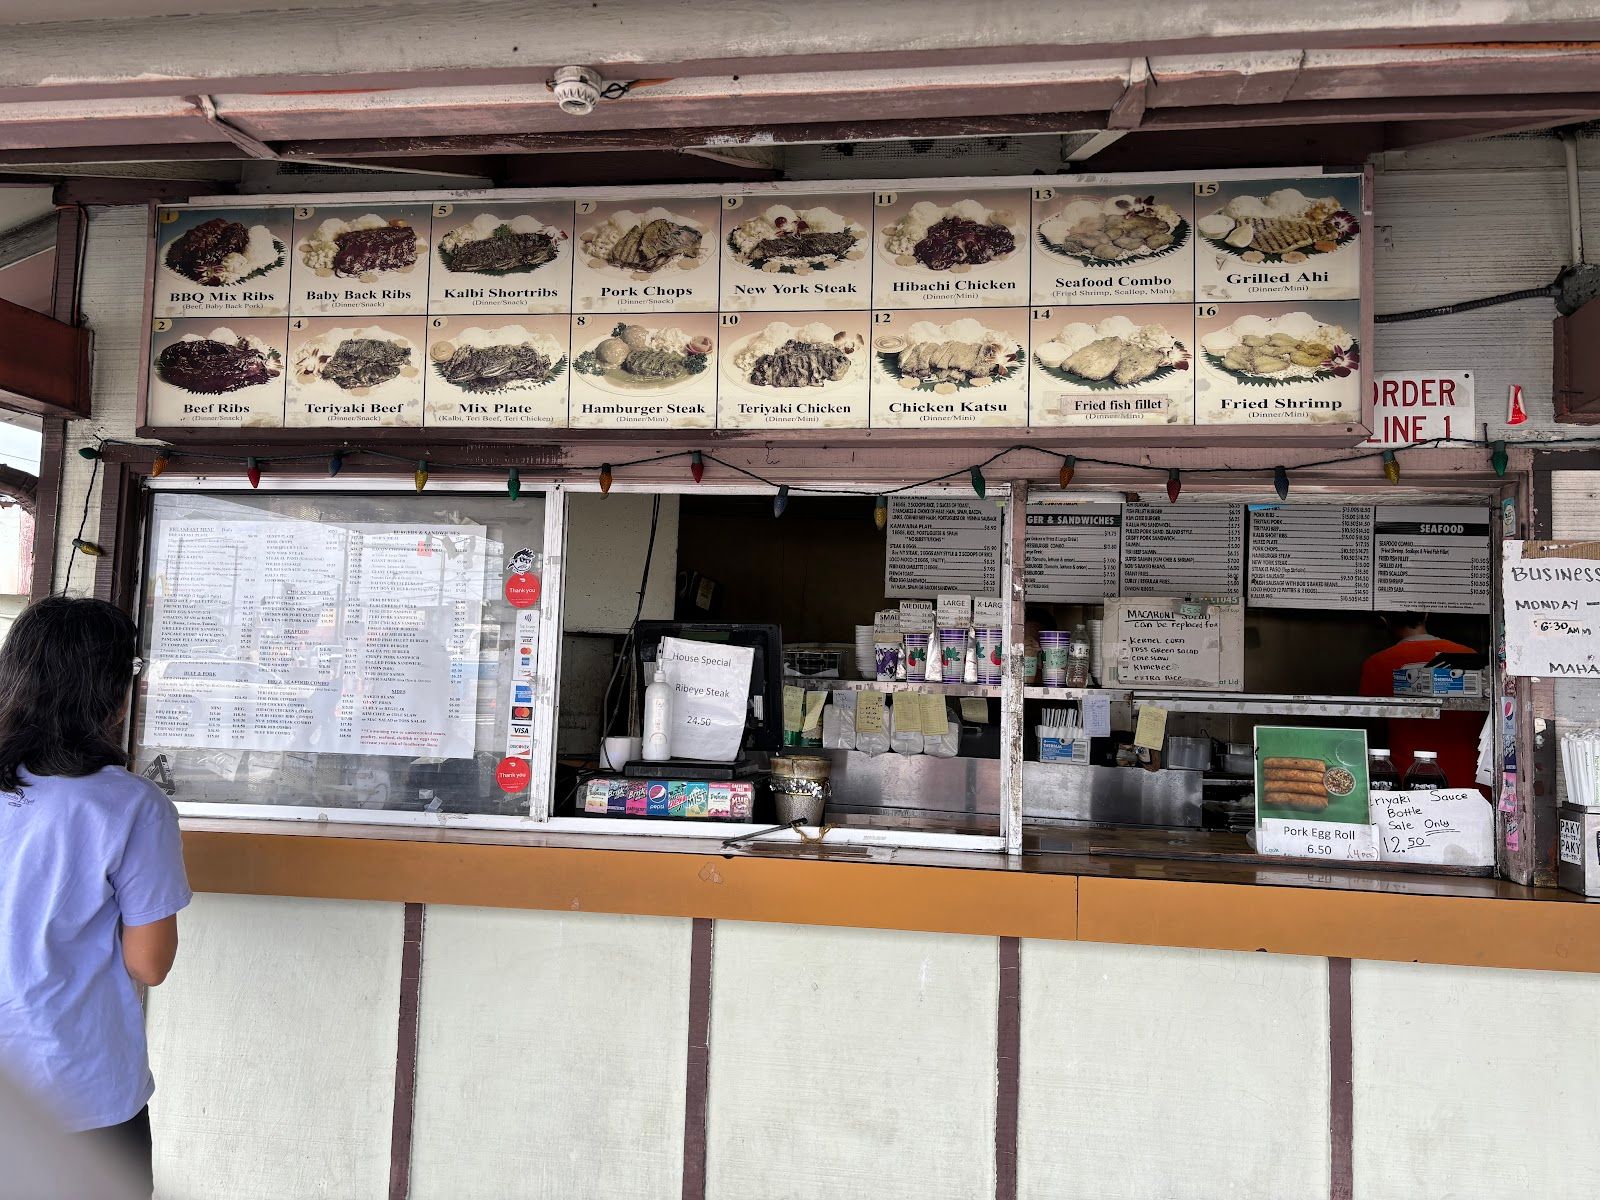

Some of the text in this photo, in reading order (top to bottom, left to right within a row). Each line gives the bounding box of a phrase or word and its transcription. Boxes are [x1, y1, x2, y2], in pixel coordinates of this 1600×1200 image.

[1034, 189, 1051, 200] 13
[1198, 184, 1216, 194] 15
[728, 197, 736, 207] 9
[877, 194, 892, 204] 11
[300, 207, 308, 217] 3
[438, 205, 447, 215] 5
[581, 203, 589, 212] 7
[1055, 276, 1172, 288] Seafood Combo
[1226, 271, 1329, 284] Grilled Ahi
[735, 283, 857, 295] New York Steak
[893, 279, 1016, 292] Hibachi Chicken
[1248, 285, 1309, 293] (Dinner/Mini)
[170, 291, 274, 304] BBQ Mix Ribs
[306, 289, 412, 303] Baby Back Ribs
[444, 287, 558, 299] Kalbi Shortribs
[601, 286, 693, 299] Pork Chops
[1079, 290, 1112, 298] Shrimp,
[1149, 288, 1176, 296] Mahi)
[182, 303, 203, 311] (Beef,
[205, 303, 223, 311] Baby
[617, 298, 674, 306] (Dinner/Snack)
[1032, 309, 1051, 320] 14
[1196, 305, 1216, 316] 16
[433, 318, 442, 327] 6
[576, 316, 586, 326] 8
[721, 315, 738, 325] 10
[874, 313, 891, 323] 12
[158, 321, 166, 330] 2
[293, 319, 302, 329] 4
[183, 402, 250, 413] Beef Ribs
[304, 403, 404, 415] Teriyaki Beef
[458, 403, 532, 413] Mix Plate
[582, 403, 706, 416] Hamburger Steak
[738, 403, 851, 415] Teriyaki Chicken
[889, 402, 1008, 413] Chicken Katsu
[1074, 399, 1163, 411] Fried fish fillet
[1220, 397, 1343, 411] Fried Shrimp
[438, 415, 464, 423] (Kalbi,
[484, 415, 502, 423] Beef,
[1443, 416, 1451, 442] 1
[1058, 516, 1115, 525] SANDWICHES
[1420, 524, 1464, 533] SEAFOOD
[1515, 600, 1579, 610] MONDAY
[1540, 621, 1568, 631] 6:30
[672, 652, 732, 667] House Special
[675, 683, 730, 698] Ribeye Steak
[687, 715, 711, 727] 24.50
[608, 787, 625, 797] Brisk
[629, 787, 646, 799] Brisk
[1430, 789, 1468, 801] Sauce
[1387, 807, 1422, 818] Bottle
[1389, 819, 1450, 831] Sale Only
[1560, 820, 1580, 835] PAKY
[1283, 826, 1355, 840] Pork Egg Roll
[1307, 844, 1332, 855] 6.50
[1560, 840, 1581, 855] PAKY
